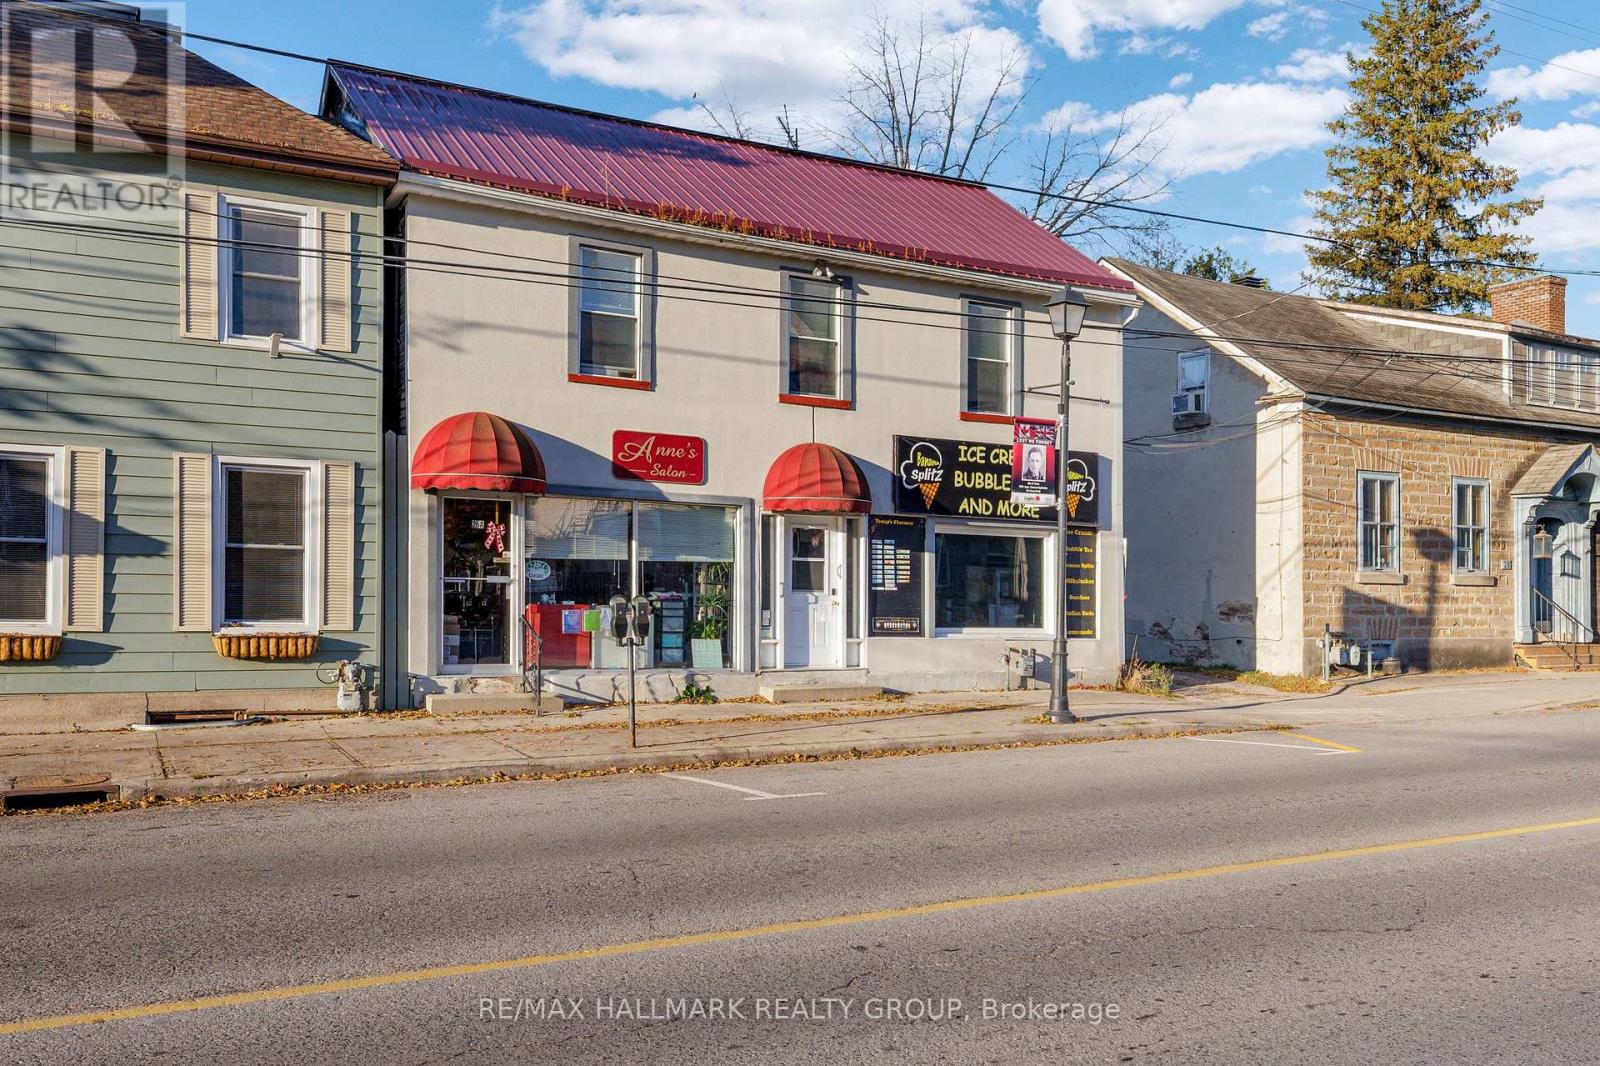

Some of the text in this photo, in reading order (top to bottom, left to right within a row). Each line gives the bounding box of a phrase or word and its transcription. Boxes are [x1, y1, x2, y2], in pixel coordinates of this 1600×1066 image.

[617, 435, 698, 463] Anne's
[958, 445, 987, 464] ICE
[650, 463, 687, 478] Salon
[953, 470, 1012, 491] BUBBLE
[958, 498, 1040, 518] AND MORE
